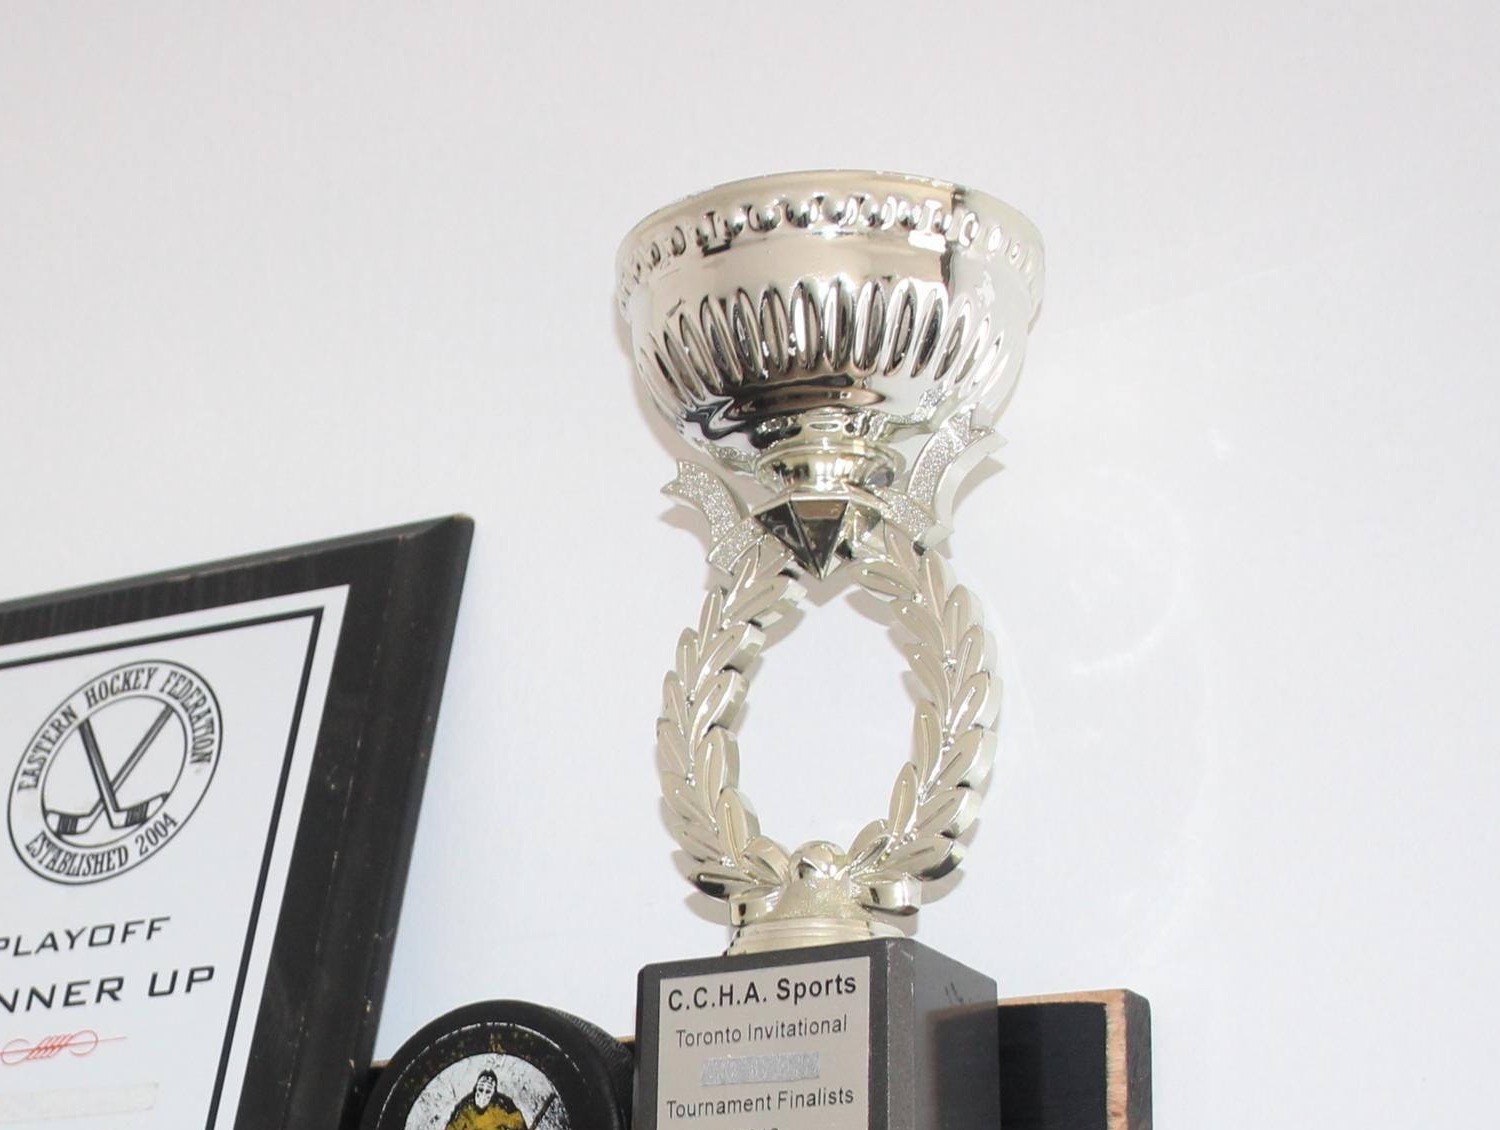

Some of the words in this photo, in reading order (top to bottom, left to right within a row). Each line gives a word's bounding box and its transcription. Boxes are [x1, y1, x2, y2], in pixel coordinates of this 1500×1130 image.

[17, 704, 78, 792] EASTERN
[83, 667, 159, 709] HOCKEY
[159, 670, 216, 765] FEDERATION
[25, 830, 129, 877] ESTABLISHED
[135, 812, 178, 856] 2004
[148, 966, 215, 997] UP
[668, 981, 767, 1011] C.C.H.A.
[776, 973, 857, 1005] Sports
[676, 1026, 742, 1048] Toronto
[748, 1013, 847, 1042] Invitational
[667, 1095, 771, 1119] Tournament
[777, 1087, 854, 1110] Finalists
